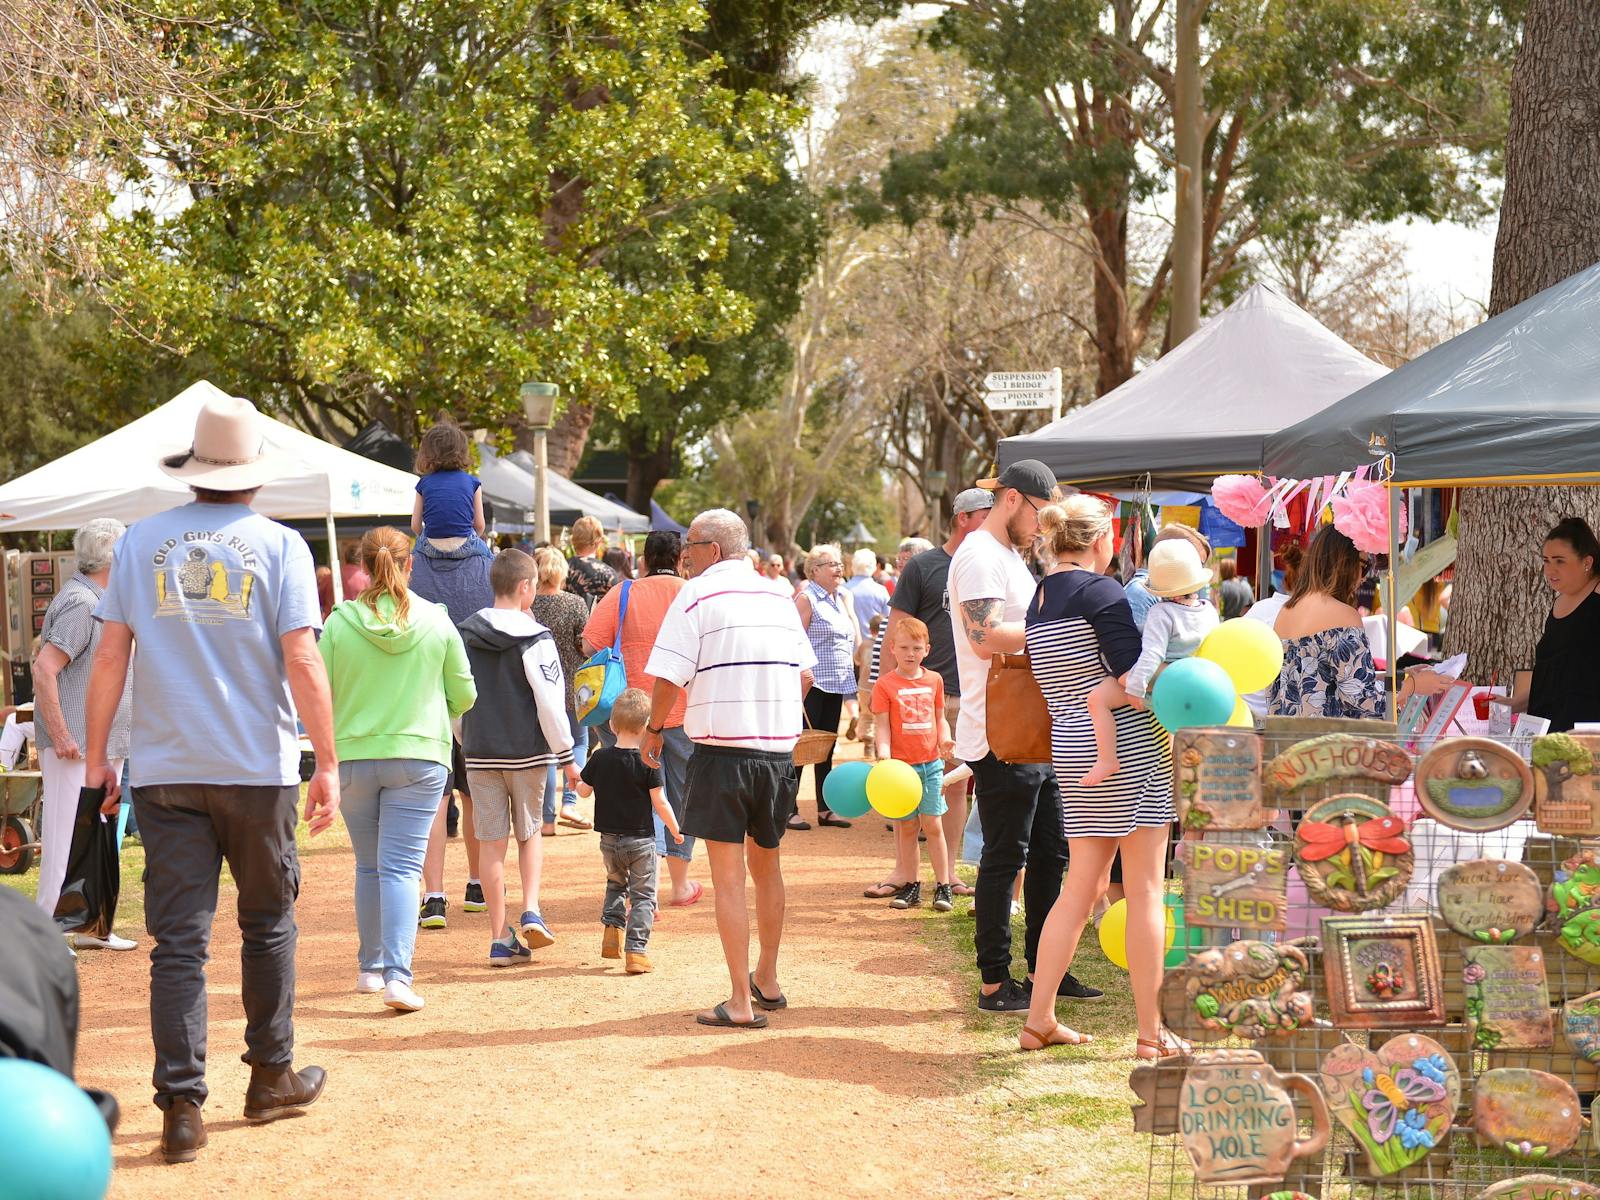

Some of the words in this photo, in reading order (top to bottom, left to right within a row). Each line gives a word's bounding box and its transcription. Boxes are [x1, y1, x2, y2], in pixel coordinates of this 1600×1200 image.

[153, 538, 178, 566] OLD
[182, 531, 224, 542] GUYS
[227, 535, 257, 568] RULE
[1274, 746, 1403, 787] NUT-HOUSE
[1193, 846, 1284, 874] POP'S
[1196, 895, 1275, 923] SHED
[1208, 967, 1288, 1004] Welcome
[1218, 1069, 1242, 1079] THE
[1189, 1083, 1279, 1107] LOCAL
[1182, 1105, 1291, 1134] DRINKING
[1208, 1134, 1267, 1159] HOLE
